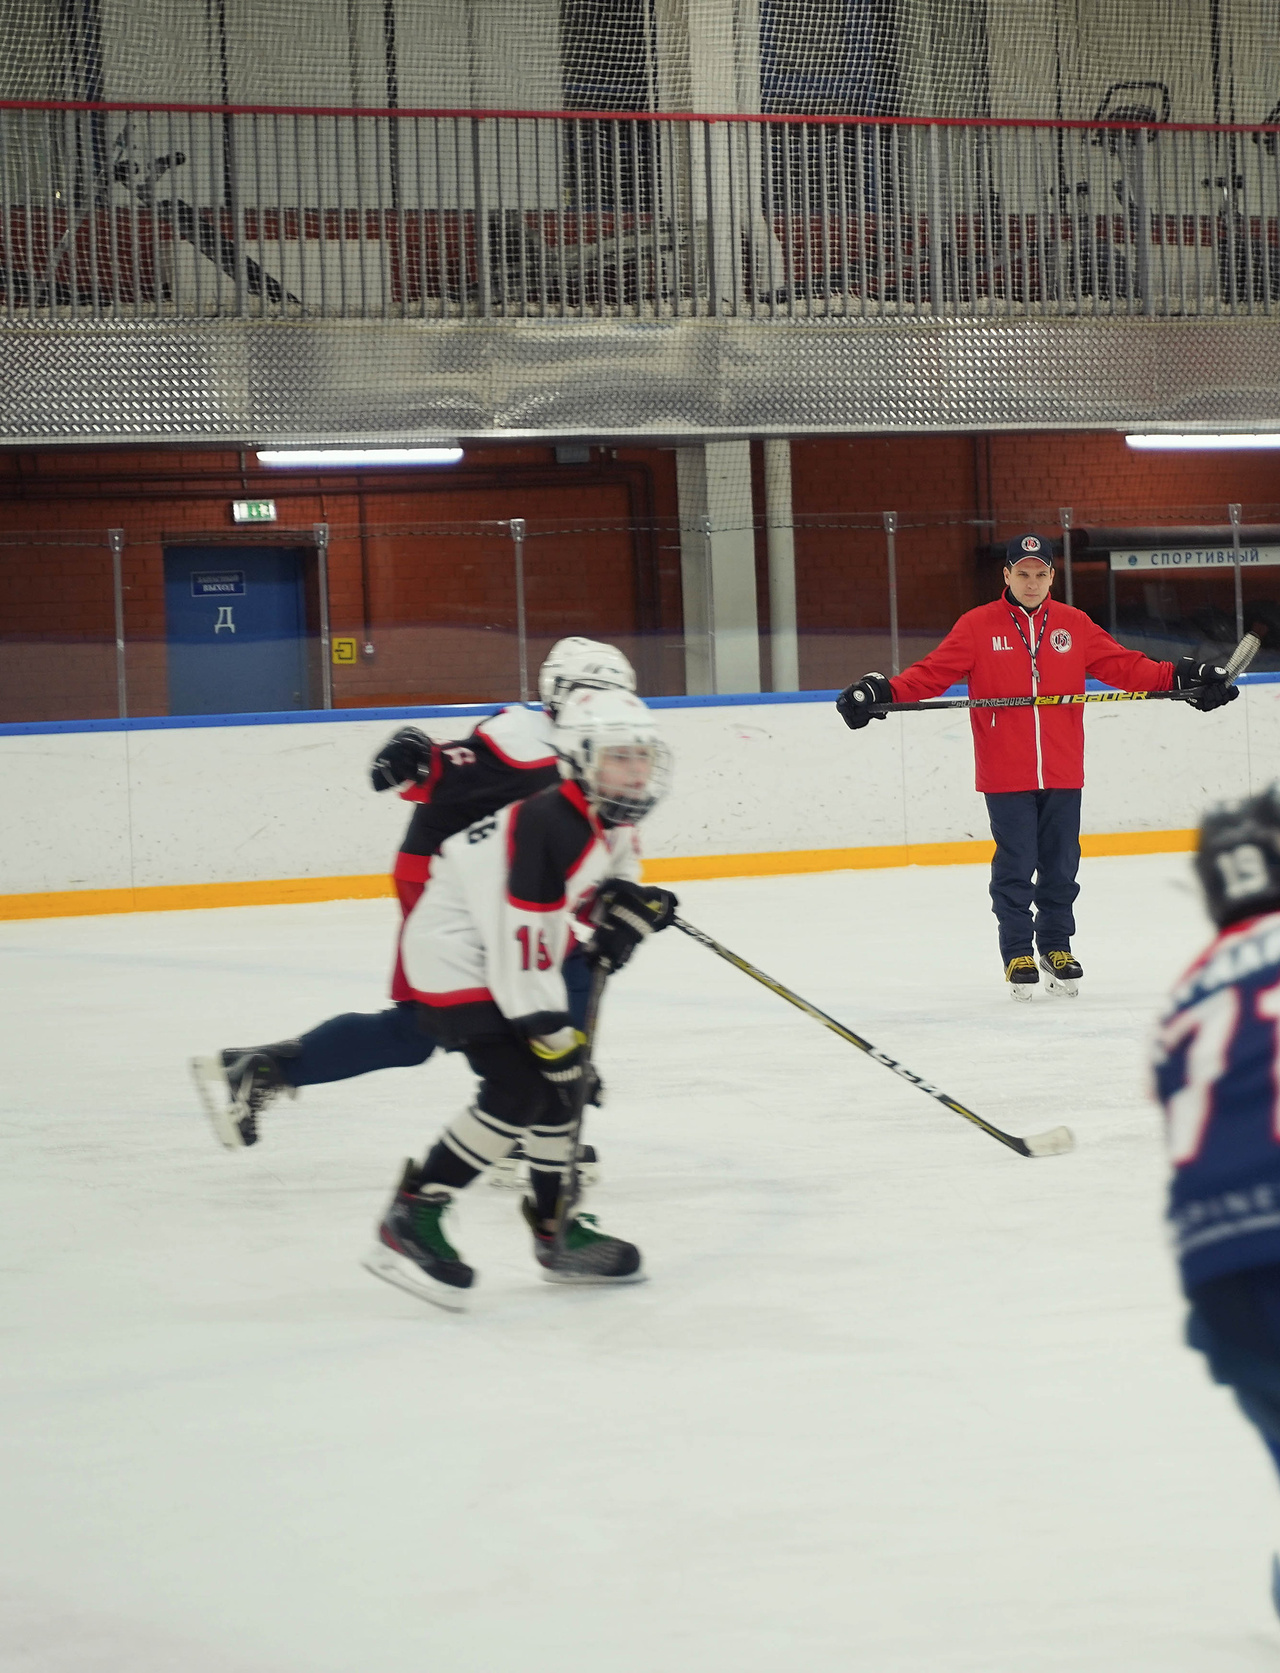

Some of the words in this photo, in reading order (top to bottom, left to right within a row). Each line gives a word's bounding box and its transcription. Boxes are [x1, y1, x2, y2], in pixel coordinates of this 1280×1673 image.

[1150, 548, 1259, 566] СПОРТИВНЫЙ
[202, 583, 235, 592] ВЫХОД
[214, 606, 236, 634] Д
[992, 636, 1013, 651] M.L.
[1072, 691, 1148, 704] BAUER
